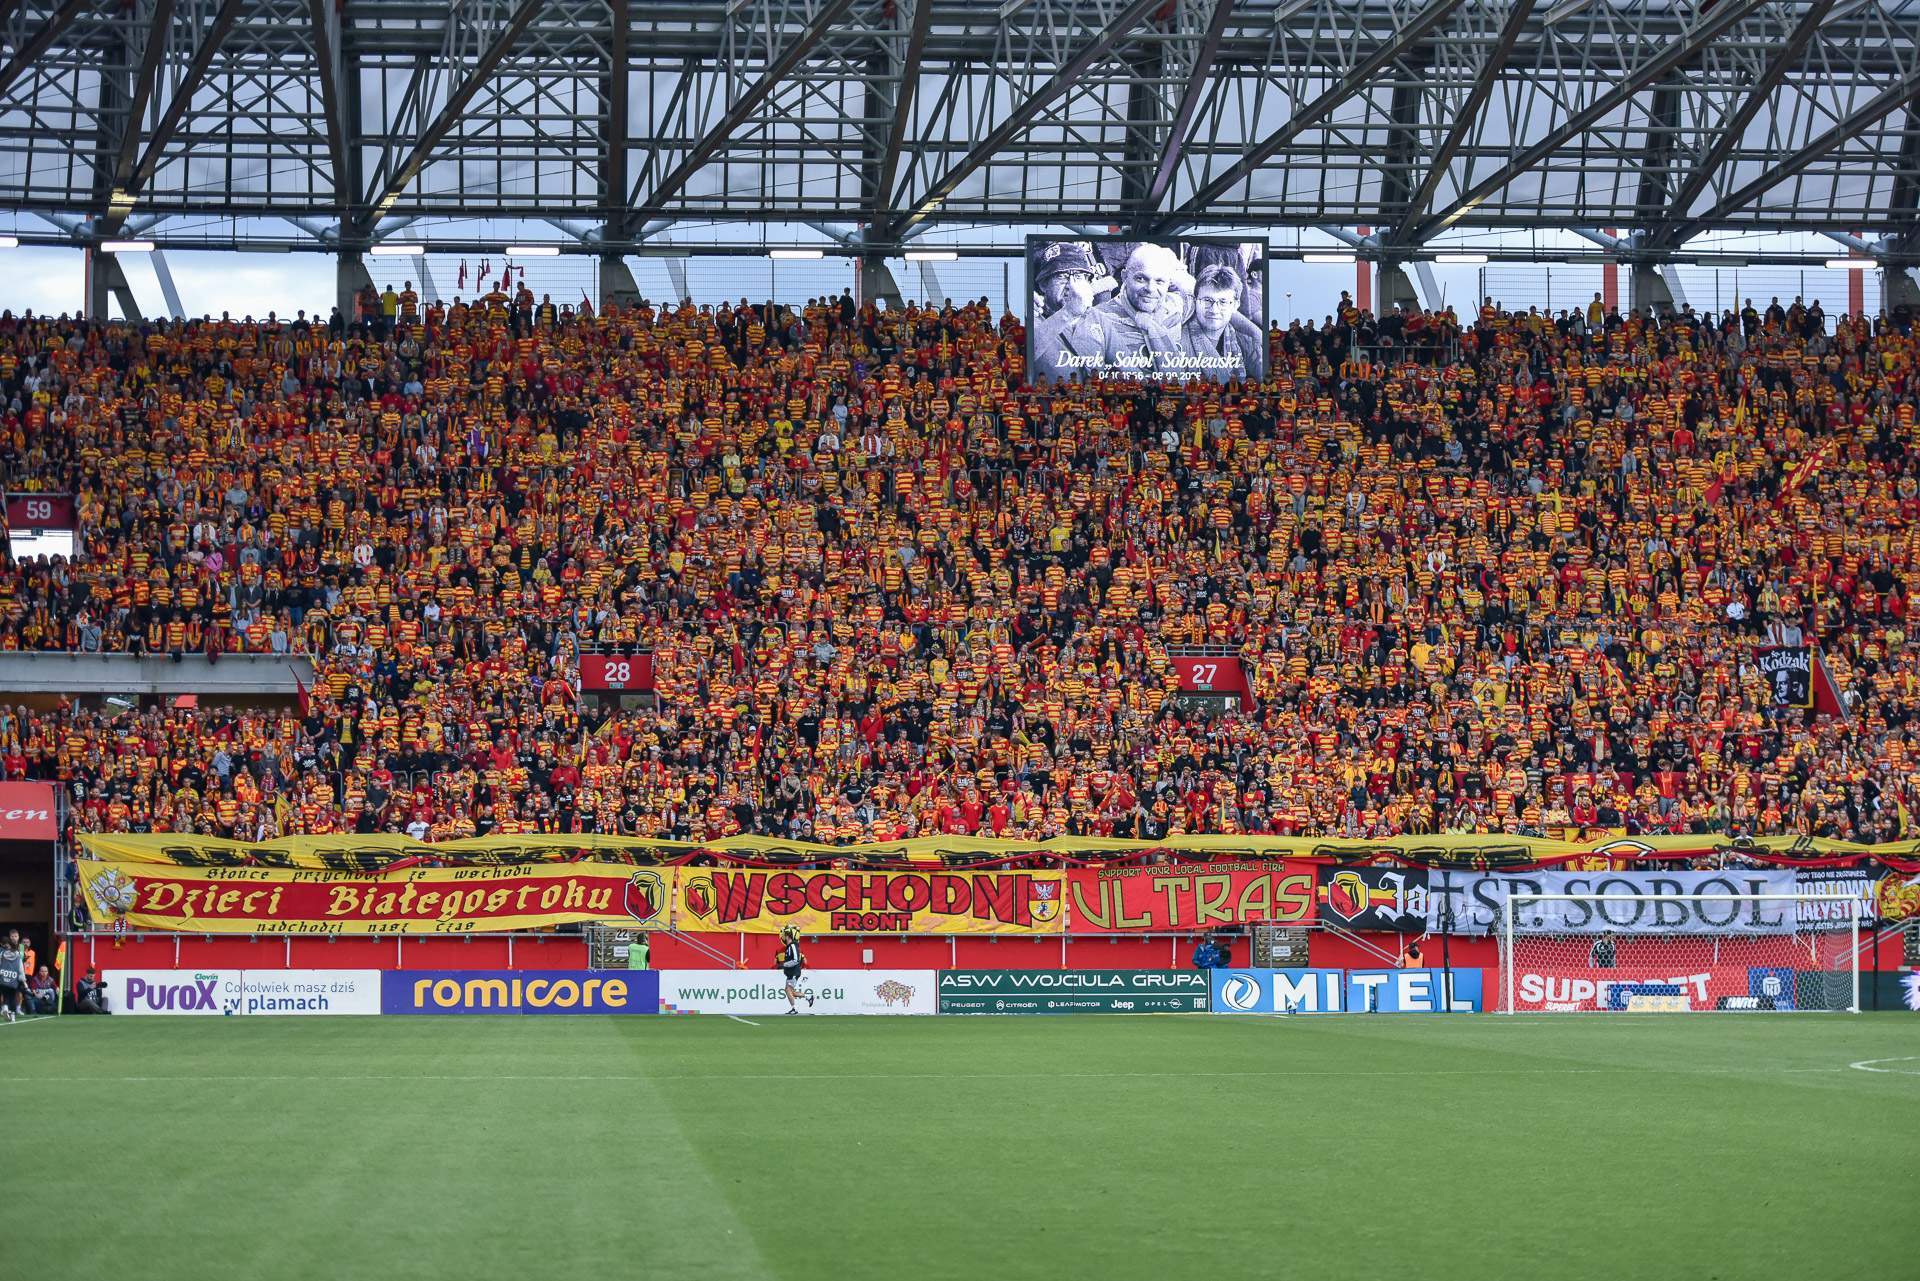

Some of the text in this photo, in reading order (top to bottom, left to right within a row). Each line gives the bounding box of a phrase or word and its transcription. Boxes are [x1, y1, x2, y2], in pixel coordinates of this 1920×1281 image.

[1055, 351, 1103, 368] Darek
[1162, 351, 1241, 368] Sobolewski
[26, 500, 52, 520] 59
[604, 662, 631, 682] 28
[1192, 664, 1218, 684] 27
[0, 808, 48, 820] en
[455, 865, 532, 879] wschodu
[1098, 868, 1141, 878] SUPPORT
[1145, 866, 1170, 875] YOUR
[1175, 865, 1204, 875] LOCAL
[1209, 863, 1258, 873] FOOTBALL
[711, 871, 1032, 927] WSCHODNI
[1795, 880, 1875, 900] PORTOWY
[143, 879, 612, 925] Dzieci Białegostoku
[1072, 873, 1313, 929] ULTRAS
[1564, 878, 1783, 927] SOBOL
[1797, 900, 1874, 920] IAŁYSTK
[831, 912, 912, 931] FRONT
[617, 929, 628, 939] 22
[1276, 928, 1287, 938] 21
[225, 981, 355, 993] Cokolwiek masz dziś
[940, 974, 1207, 987] ASW WOJCIULA GRUPA
[126, 977, 217, 1010] PuroX
[413, 978, 628, 1007] romicore
[678, 984, 844, 1003] www.podlasie.eu
[1272, 972, 1473, 1012] MITEL
[249, 995, 328, 1013] plamach
[1111, 1000, 1134, 1010] Jeep
[1193, 998, 1207, 1009] FIAT
